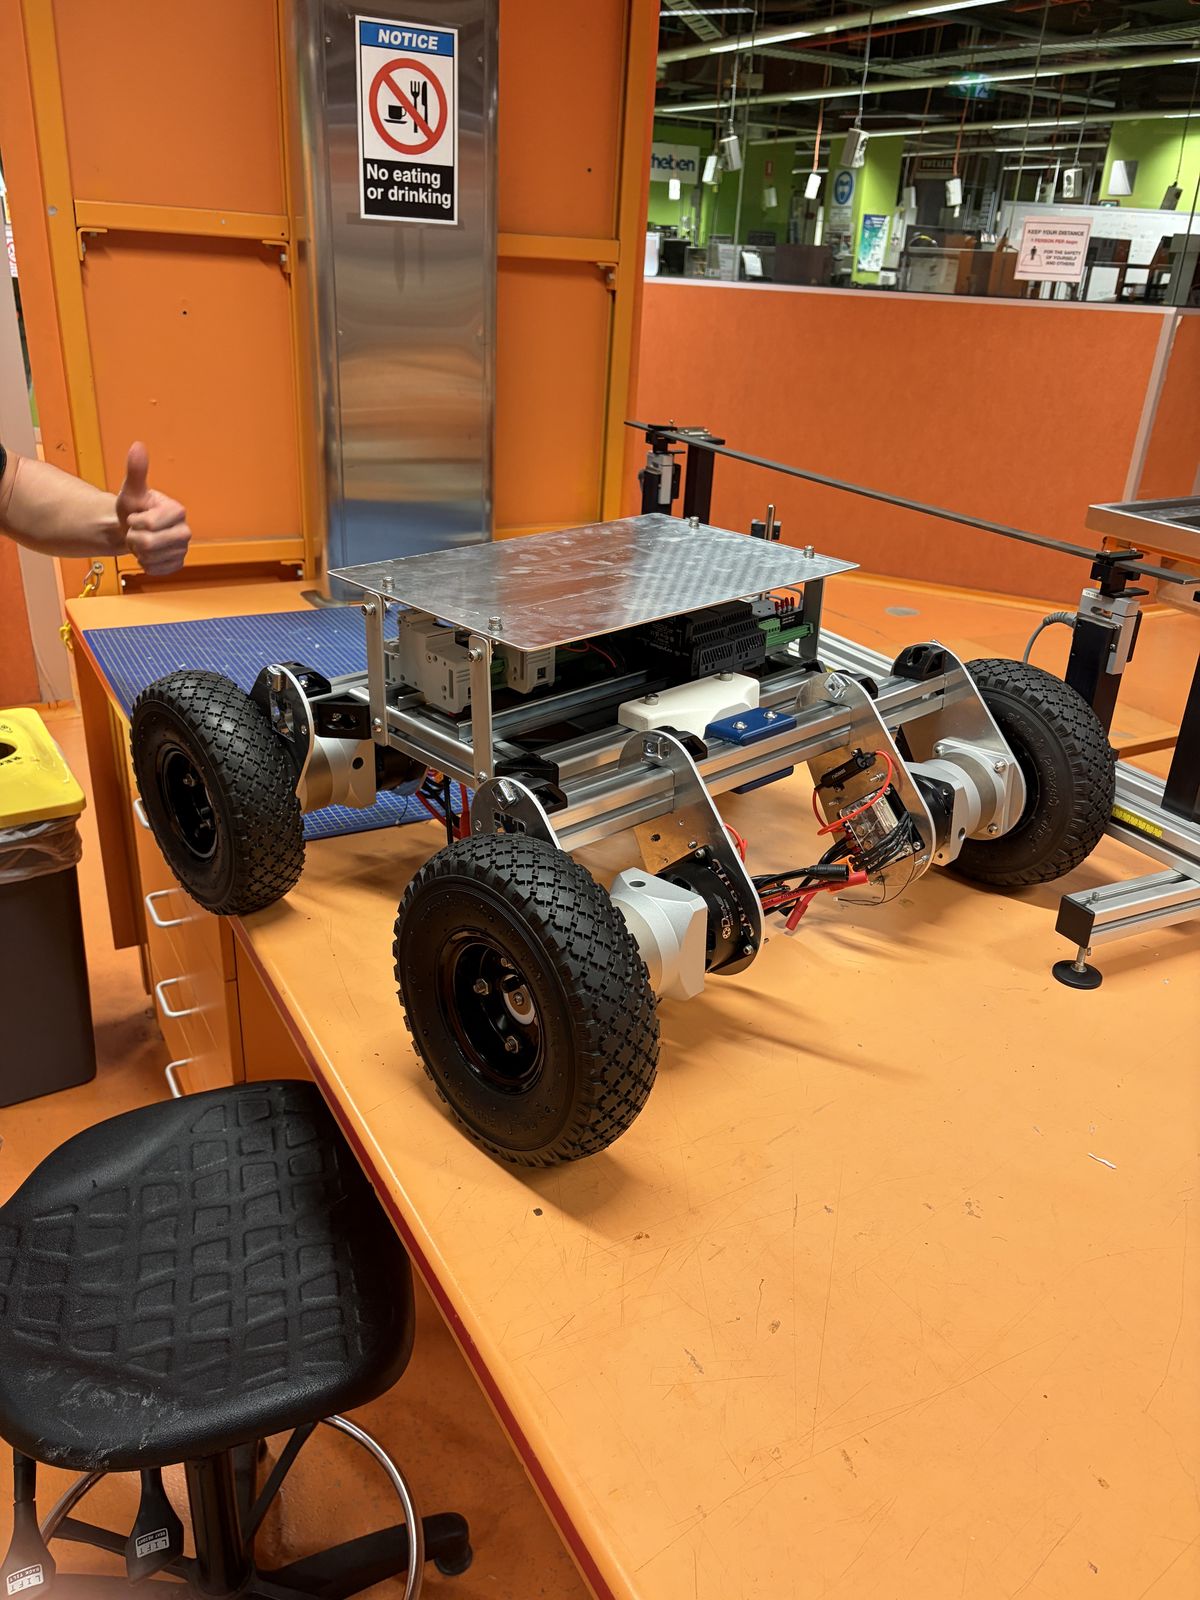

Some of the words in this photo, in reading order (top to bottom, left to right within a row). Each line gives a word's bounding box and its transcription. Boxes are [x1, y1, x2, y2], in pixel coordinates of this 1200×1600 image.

[378, 28, 438, 50] NOTICE
[651, 153, 694, 172] heben
[366, 163, 388, 180] No
[392, 169, 441, 188] eating
[367, 187, 384, 200] or
[388, 186, 452, 208] drinking
[139, 1540, 167, 1555] LIFT
[10, 1575, 41, 1592] LIFT
